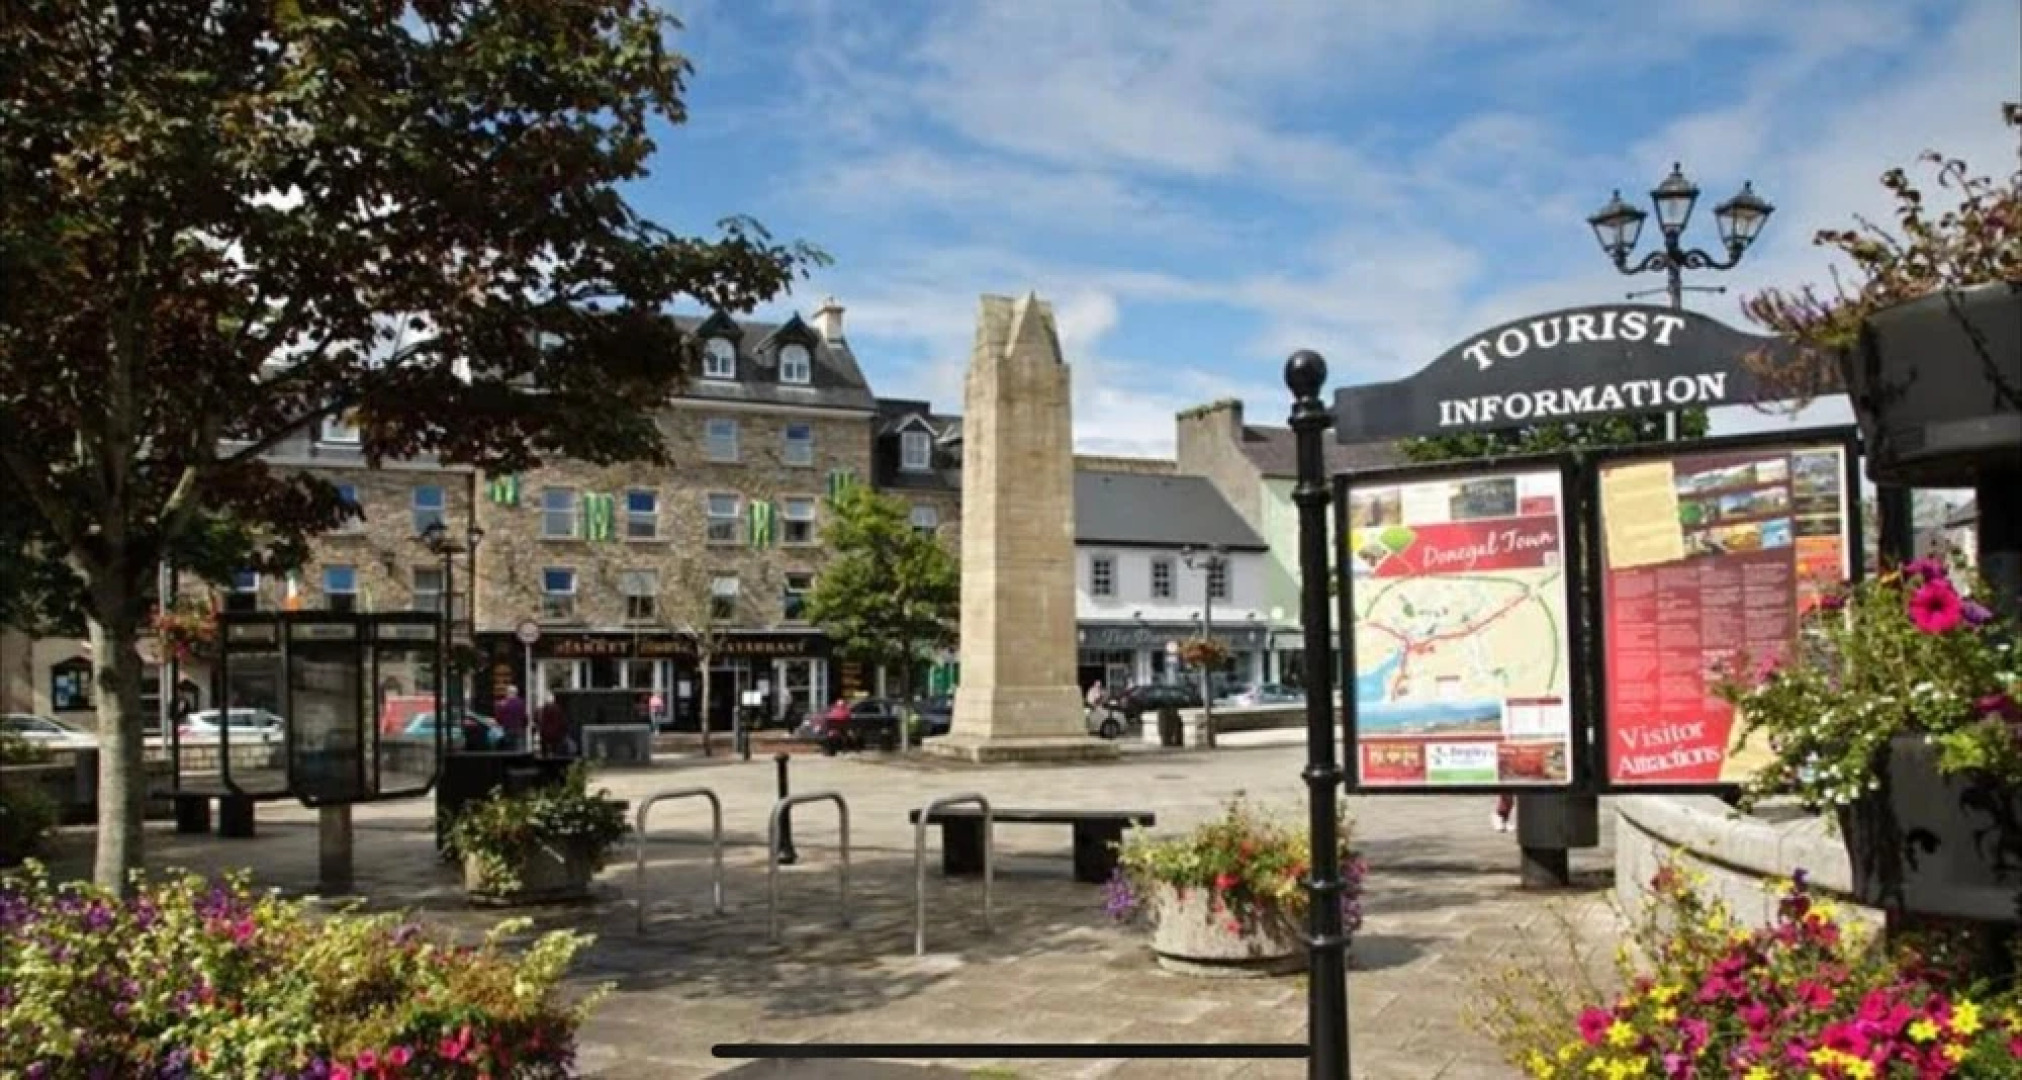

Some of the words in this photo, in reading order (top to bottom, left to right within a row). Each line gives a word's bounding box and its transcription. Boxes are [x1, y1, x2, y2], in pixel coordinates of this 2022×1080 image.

[1463, 311, 1685, 371] TOURIST
[1439, 372, 1727, 427] INFORMATION
[1422, 531, 1498, 569] Donegal
[1501, 529, 1556, 549] Town
[1618, 721, 1706, 750] Visitor
[1617, 745, 1721, 777] Attractions
